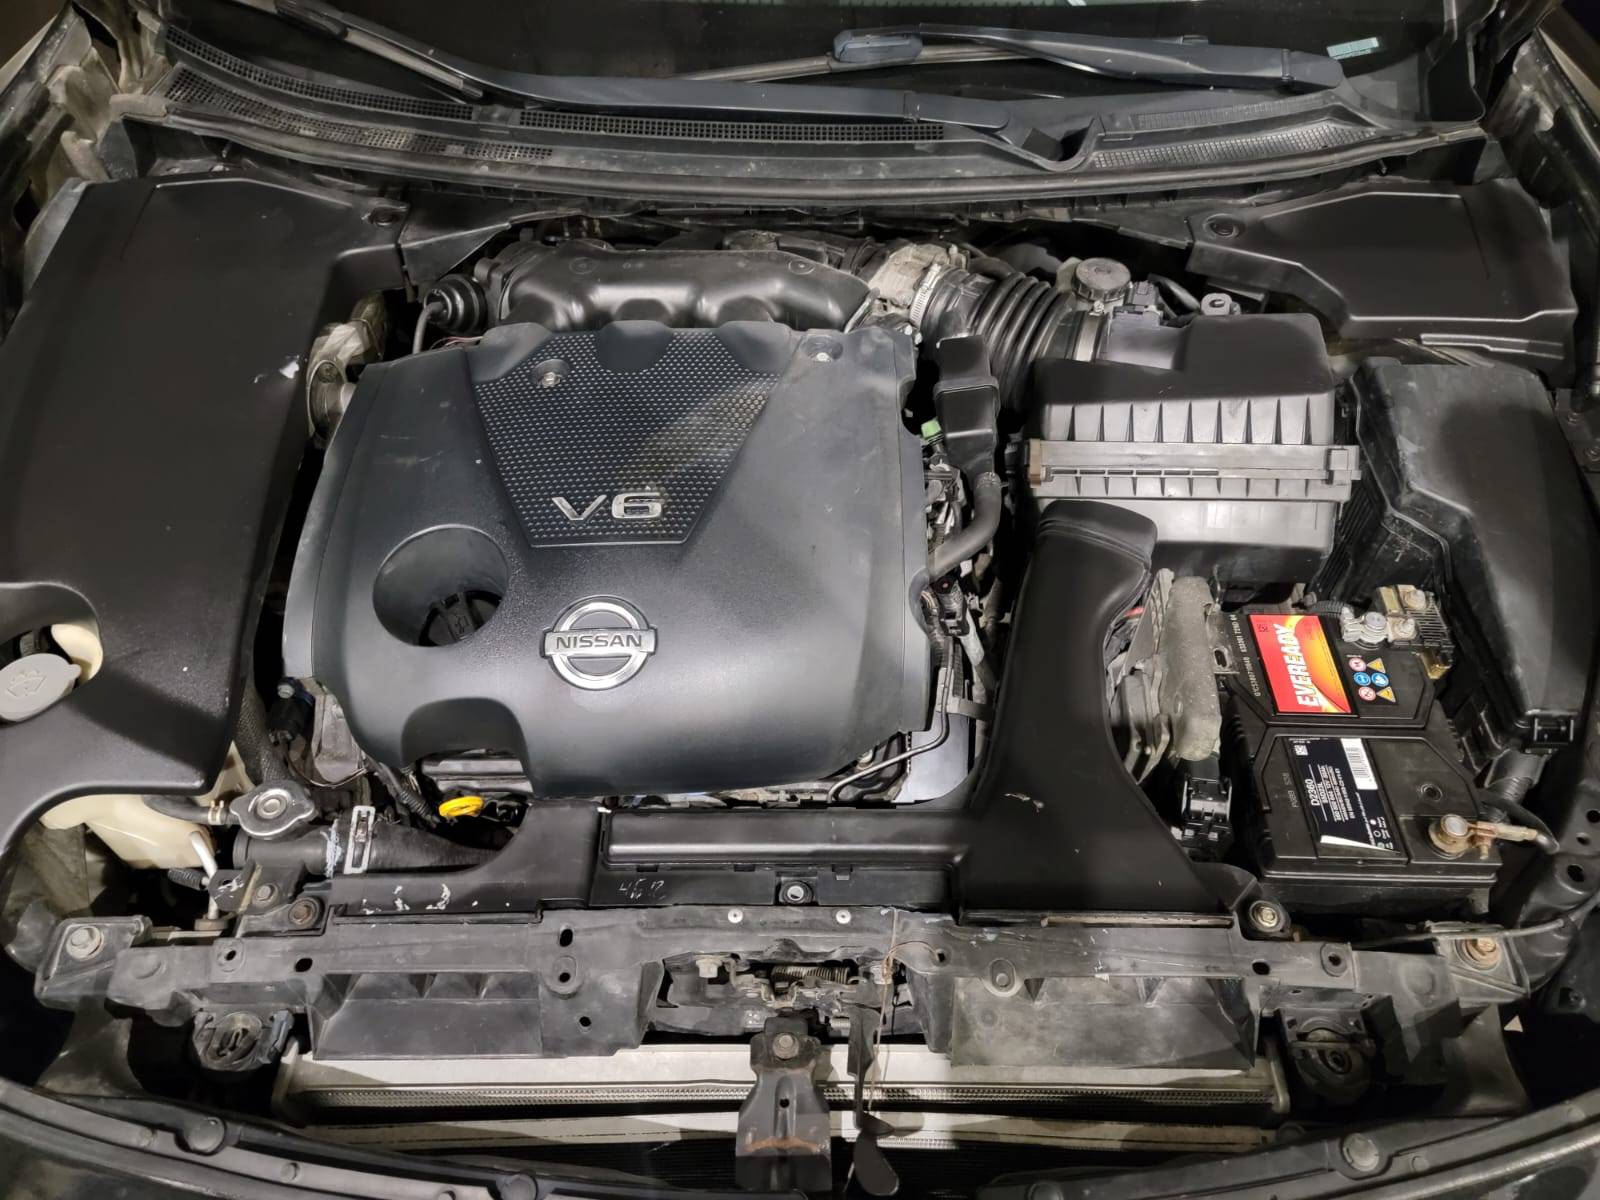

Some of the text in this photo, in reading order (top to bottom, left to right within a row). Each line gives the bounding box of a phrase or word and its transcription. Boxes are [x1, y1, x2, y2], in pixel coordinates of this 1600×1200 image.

[551, 492, 662, 520] V6
[556, 634, 642, 650] NISSAN
[1273, 623, 1321, 707] EVEREADY
[1304, 778, 1321, 806] D2360
